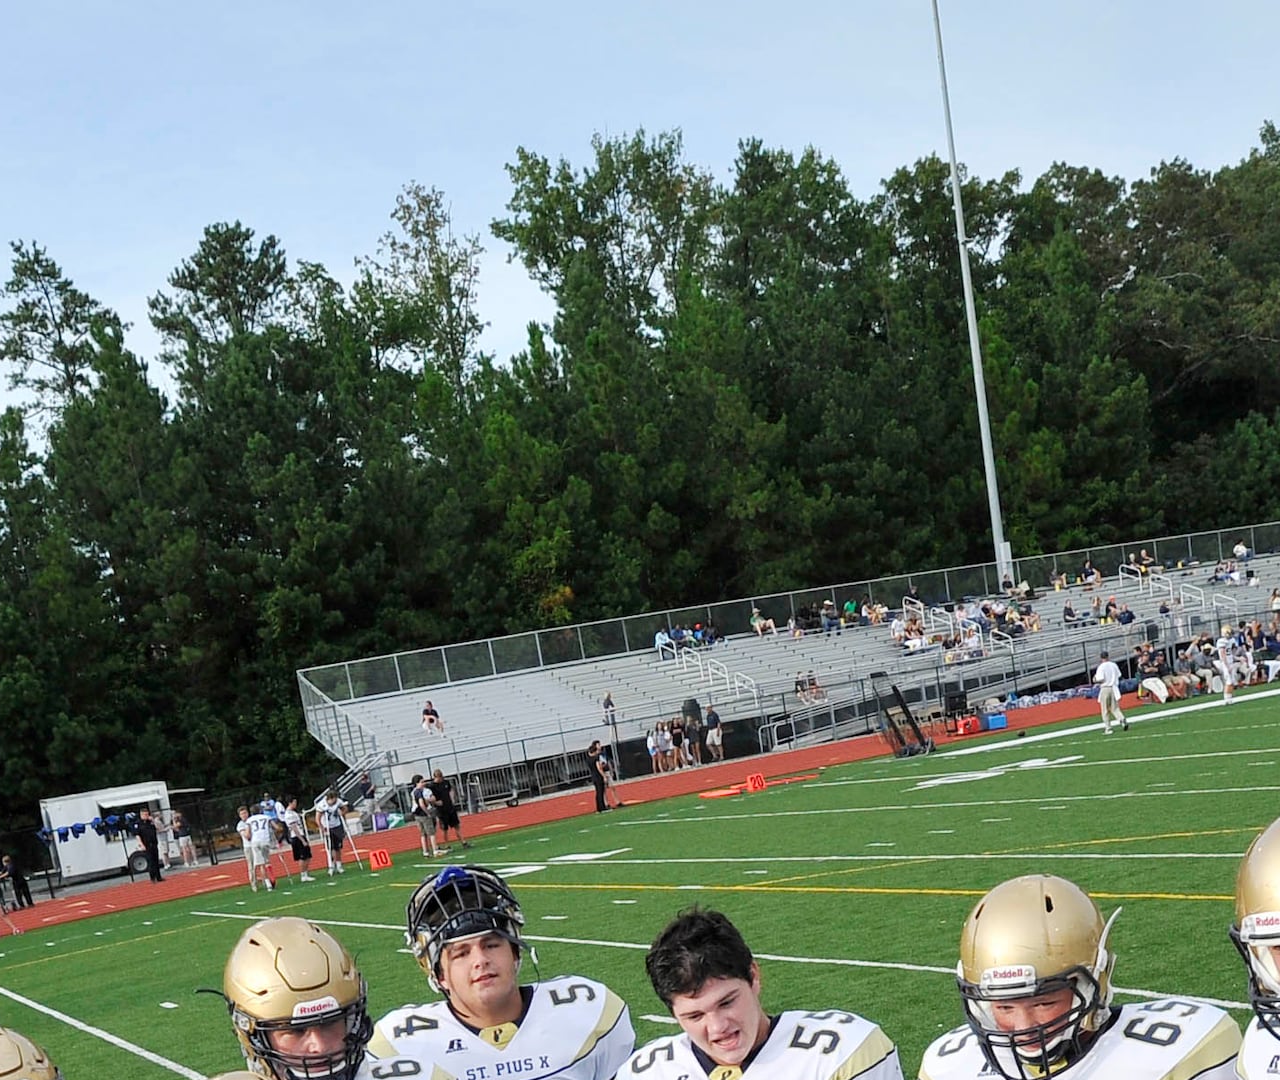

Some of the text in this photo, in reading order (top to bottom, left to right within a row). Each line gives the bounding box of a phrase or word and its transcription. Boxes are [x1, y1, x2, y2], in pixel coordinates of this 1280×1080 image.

[749, 774, 764, 791] 20
[250, 818, 268, 832] 37
[372, 851, 389, 866] 10
[992, 968, 1024, 980] Riddell
[495, 1057, 534, 1076] PIUS
[539, 1055, 550, 1069] X
